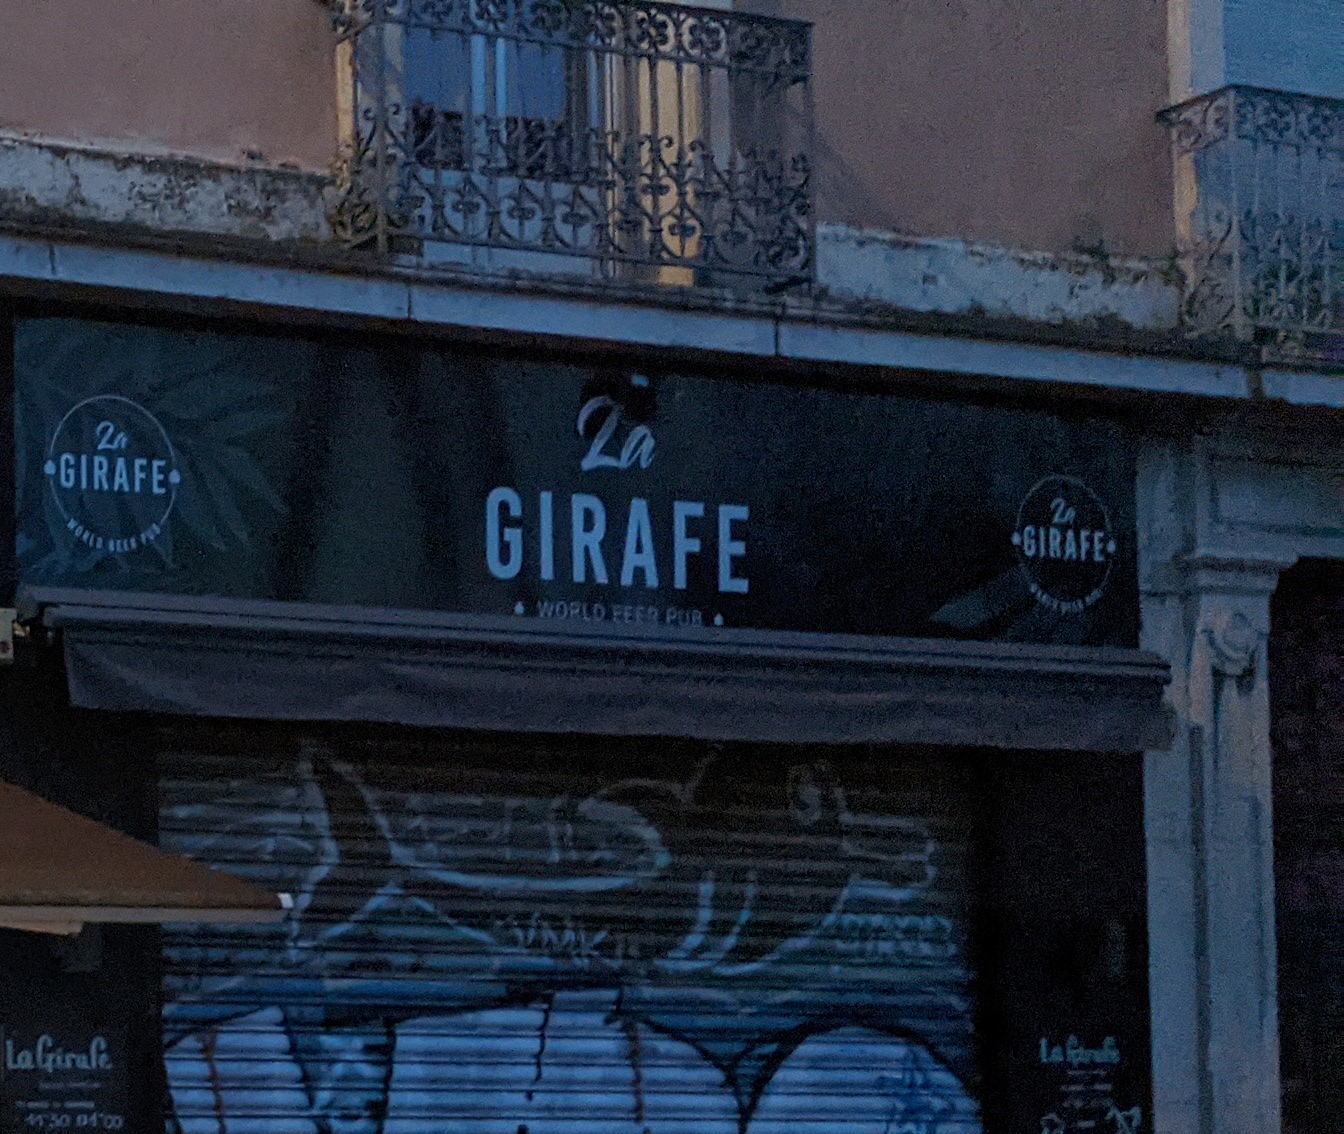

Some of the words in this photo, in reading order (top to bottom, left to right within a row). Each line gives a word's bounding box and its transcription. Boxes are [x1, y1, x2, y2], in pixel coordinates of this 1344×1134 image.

[59, 452, 166, 494] GIRAFE
[486, 486, 750, 595] GIRAFE
[1023, 525, 1106, 562] GIRAFE
[536, 602, 606, 622] WORLD
